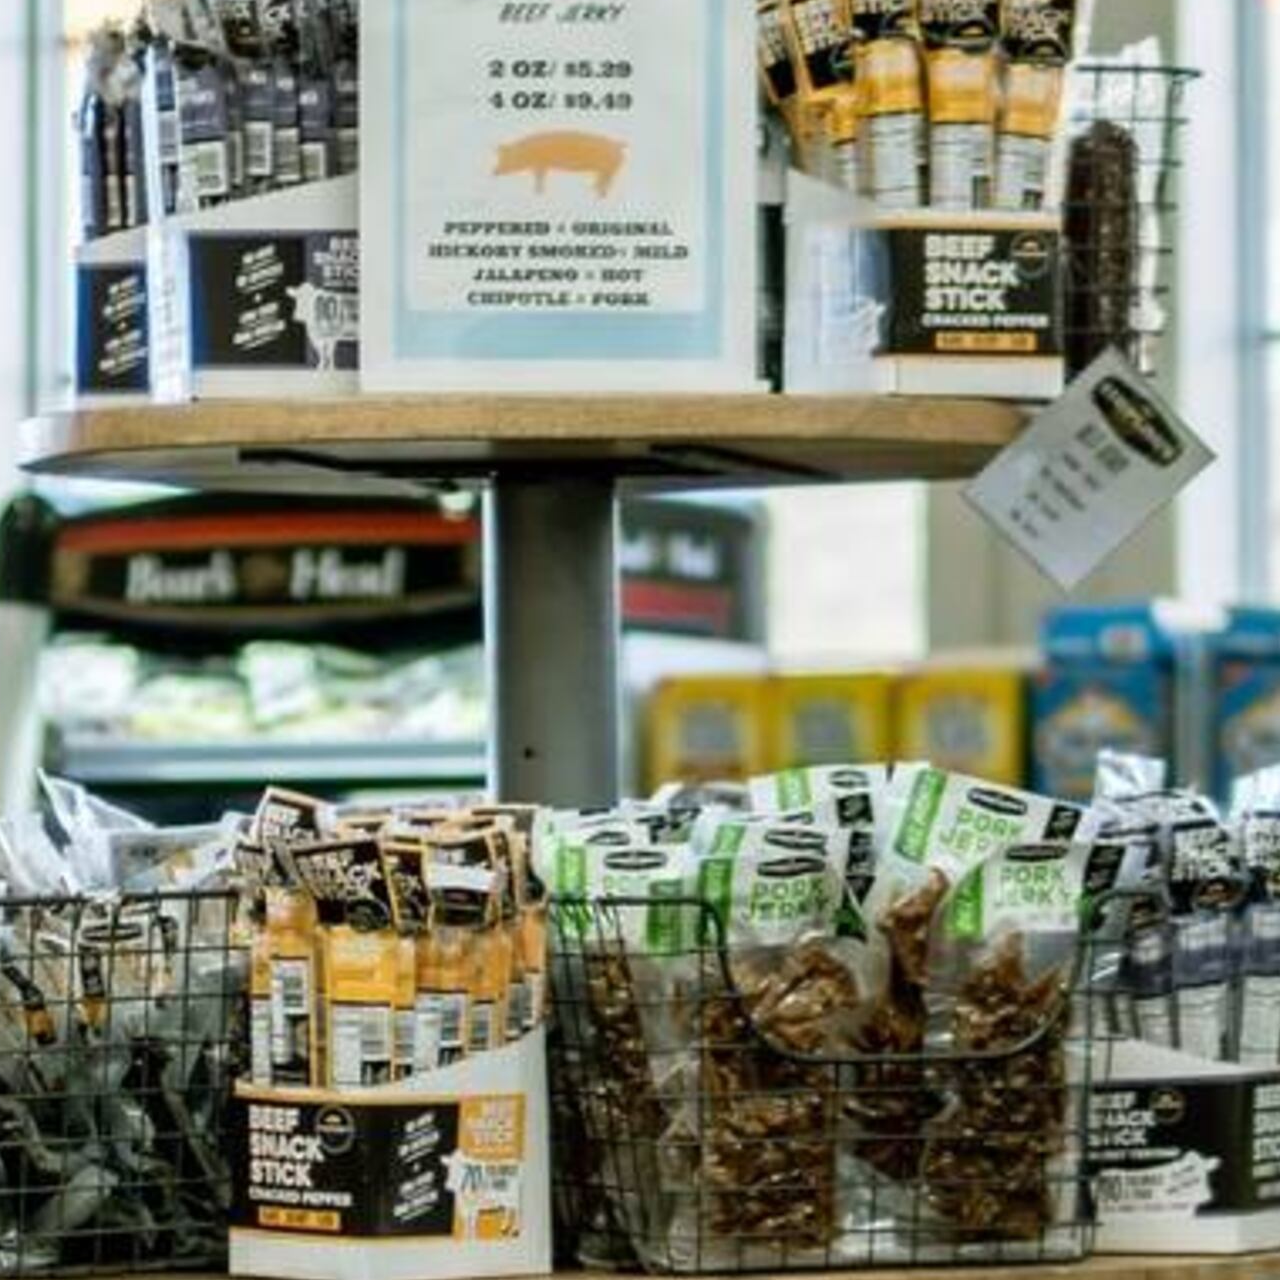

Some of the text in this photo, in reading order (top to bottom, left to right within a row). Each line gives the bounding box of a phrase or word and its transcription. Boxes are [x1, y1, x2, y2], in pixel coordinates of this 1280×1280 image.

[498, 2, 626, 22] BEEF JERKY
[487, 59, 505, 79] 2
[564, 59, 634, 79] $5.29
[488, 91, 505, 110] 4
[443, 221, 675, 236] PEPPERED ORIGINAL
[428, 244, 690, 260] HICKORY SMOKED MILD
[924, 233, 995, 259] BEEF
[601, 268, 645, 282] HOT
[924, 260, 1020, 286] SNACK
[466, 291, 651, 306] CHIPOTLE PORK
[924, 286, 1007, 311] STICK
[940, 827, 987, 857] JER
[999, 864, 1065, 886] PORK
[752, 878, 823, 902] PORK
[995, 883, 1078, 907] JERKY
[248, 1105, 300, 1132] BEEF
[249, 1132, 324, 1162] SNACK
[250, 1159, 313, 1188] STICK
